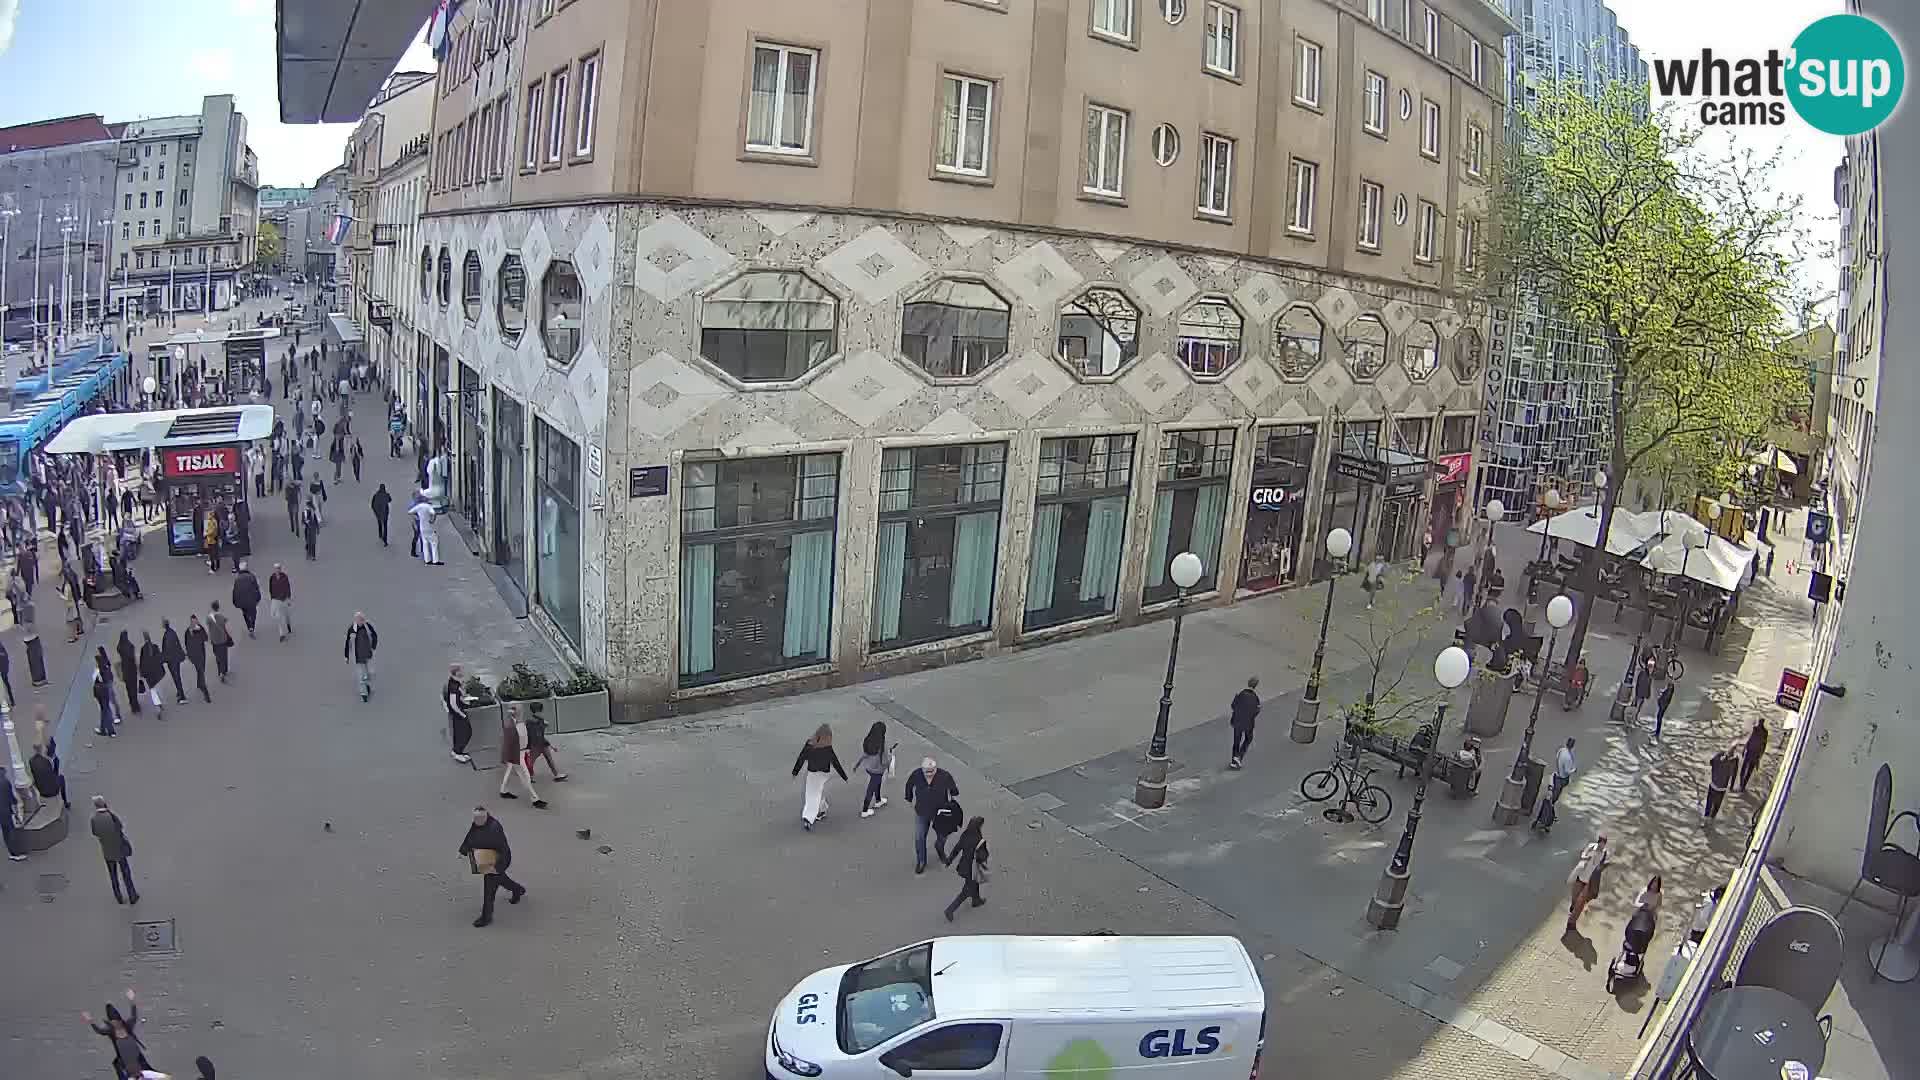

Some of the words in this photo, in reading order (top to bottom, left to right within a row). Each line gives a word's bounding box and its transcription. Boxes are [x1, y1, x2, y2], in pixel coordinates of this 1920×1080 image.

[1481, 309, 1507, 442] DUBROVNIK
[176, 453, 225, 472] TISAK
[1253, 488, 1284, 503] CRO
[796, 993, 819, 1025] GLS
[1138, 1026, 1221, 1058] GLS
